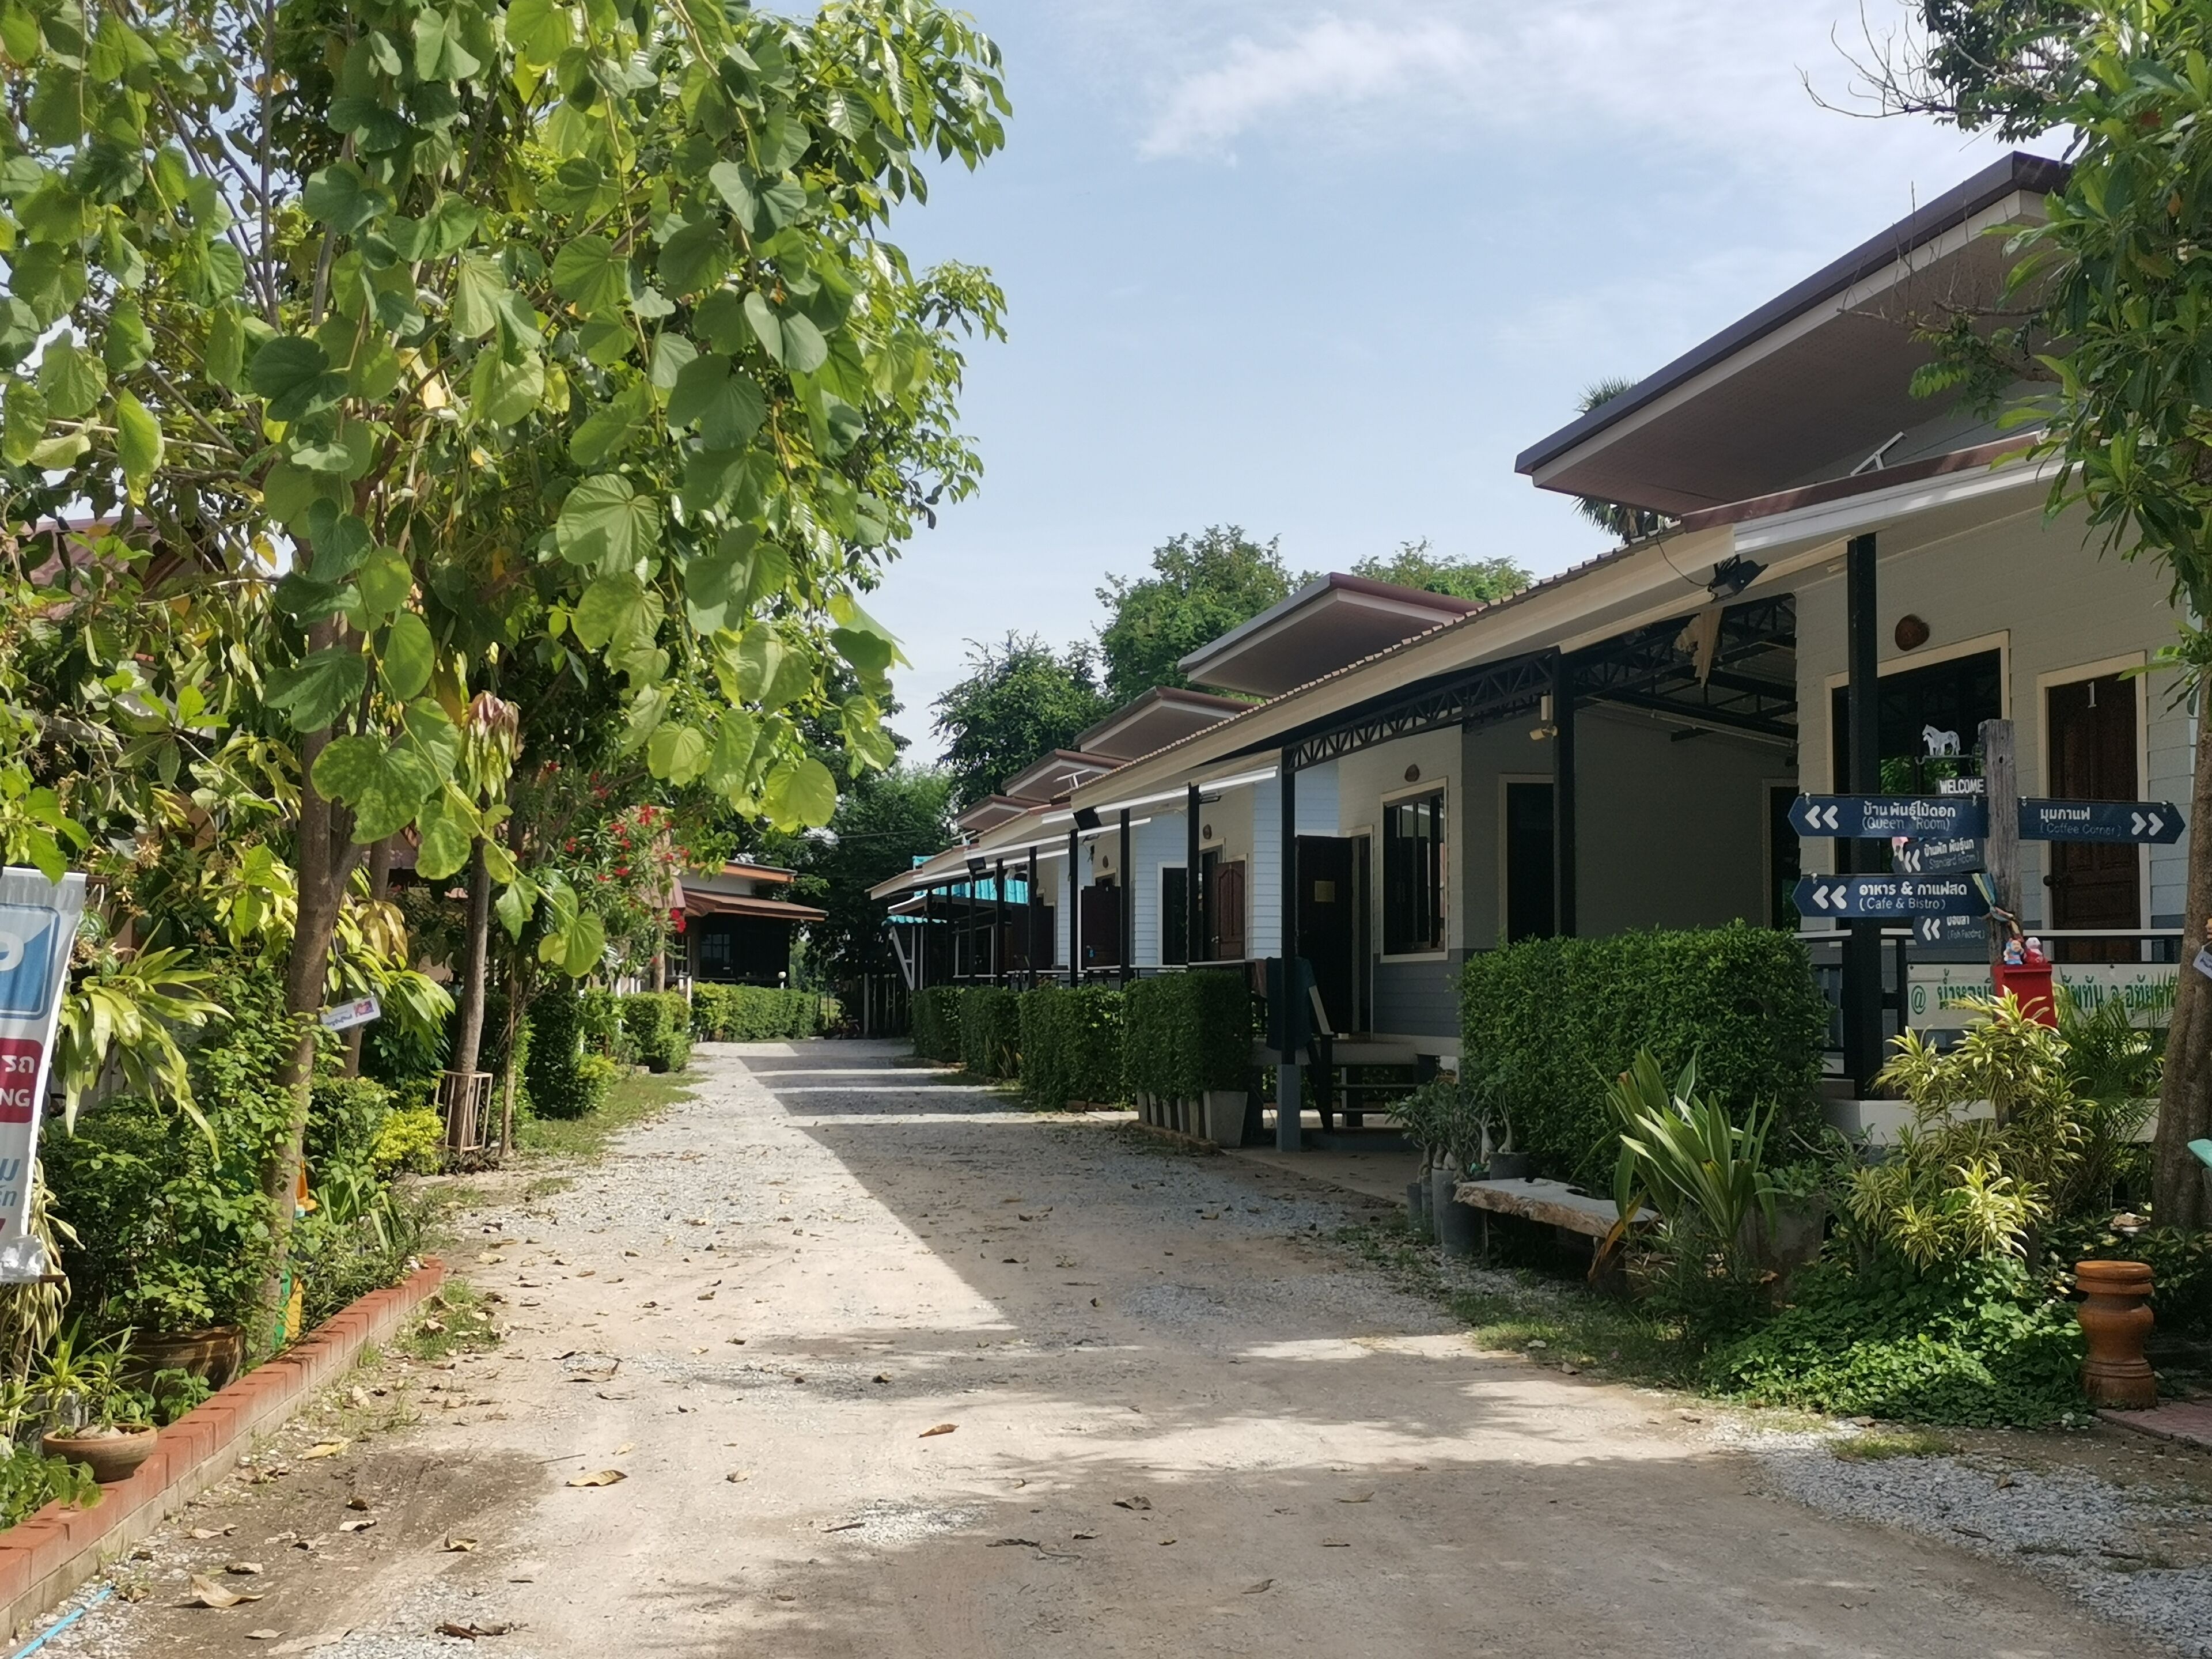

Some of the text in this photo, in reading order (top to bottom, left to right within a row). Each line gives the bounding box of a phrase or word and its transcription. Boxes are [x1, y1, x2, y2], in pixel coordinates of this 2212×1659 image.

[2087, 681, 2097, 709] 1
[1939, 778, 1984, 794] WELCOME
[2040, 806, 2090, 823] มุมกาแฟ
[1862, 816, 1950, 832] (Queen Room)
[2040, 823, 2122, 837] (Coffee Corner)
[1859, 881, 1968, 896] อาหาร & กาแฟสด
[1859, 897, 1946, 911] (Cafe & Bistro)
[1911, 984, 1926, 1015] @
